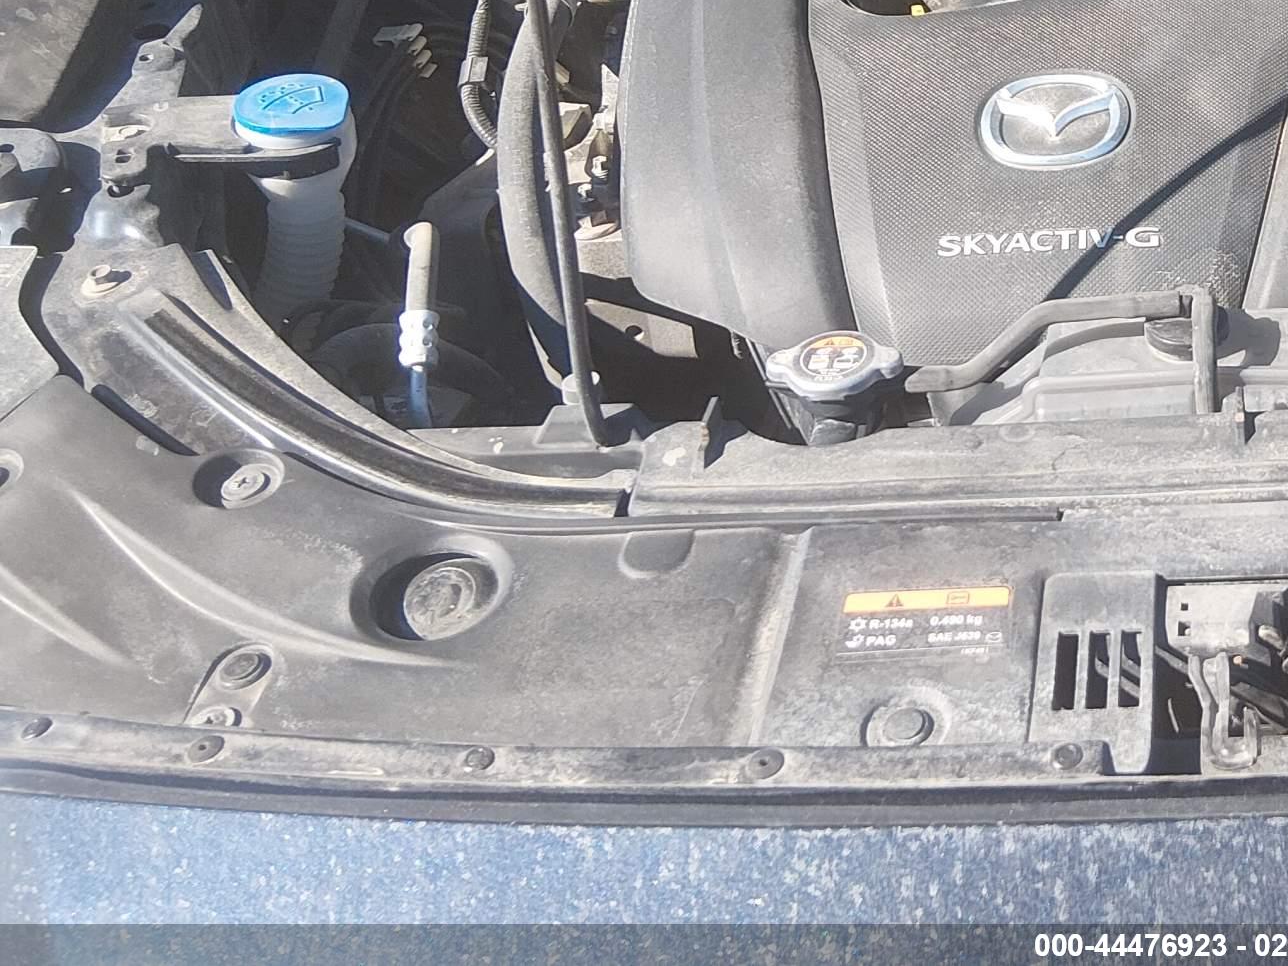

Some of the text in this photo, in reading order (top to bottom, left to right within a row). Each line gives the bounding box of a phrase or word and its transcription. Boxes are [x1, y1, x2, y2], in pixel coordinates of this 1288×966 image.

[936, 226, 1161, 257] SKYACTIV-G
[868, 618, 913, 630] R-134a
[966, 614, 983, 626] kg
[865, 635, 897, 647] PAG
[927, 632, 953, 643] SAE
